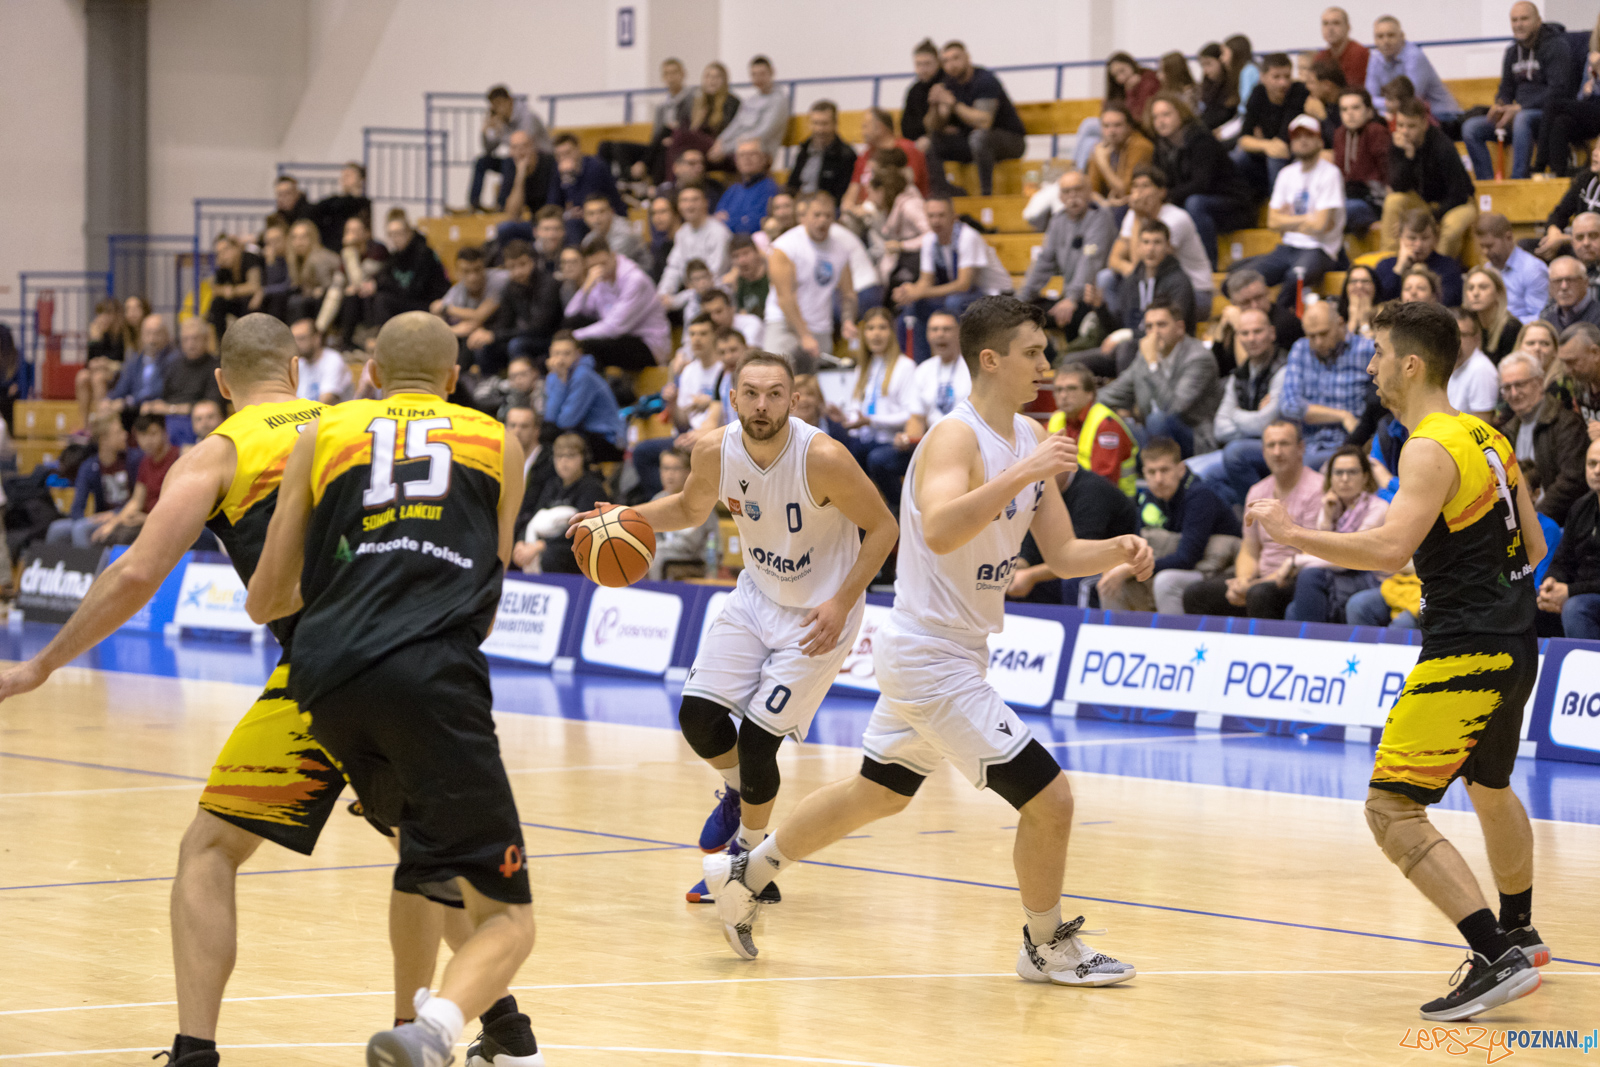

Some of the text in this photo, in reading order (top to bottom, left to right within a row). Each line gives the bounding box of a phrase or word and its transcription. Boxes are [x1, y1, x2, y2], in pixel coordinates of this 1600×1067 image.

[263, 406, 327, 429] KULIKOW
[386, 407, 436, 417] KLIMA
[362, 416, 454, 510] 15
[400, 502, 444, 521] ŁAŃCUT
[786, 502, 802, 533] 0
[355, 536, 474, 569] Anocote Polska
[499, 592, 550, 616] ELMEX
[494, 619, 544, 634] HIBITIONS
[989, 649, 1047, 673] FARM
[765, 684, 792, 715] 0
